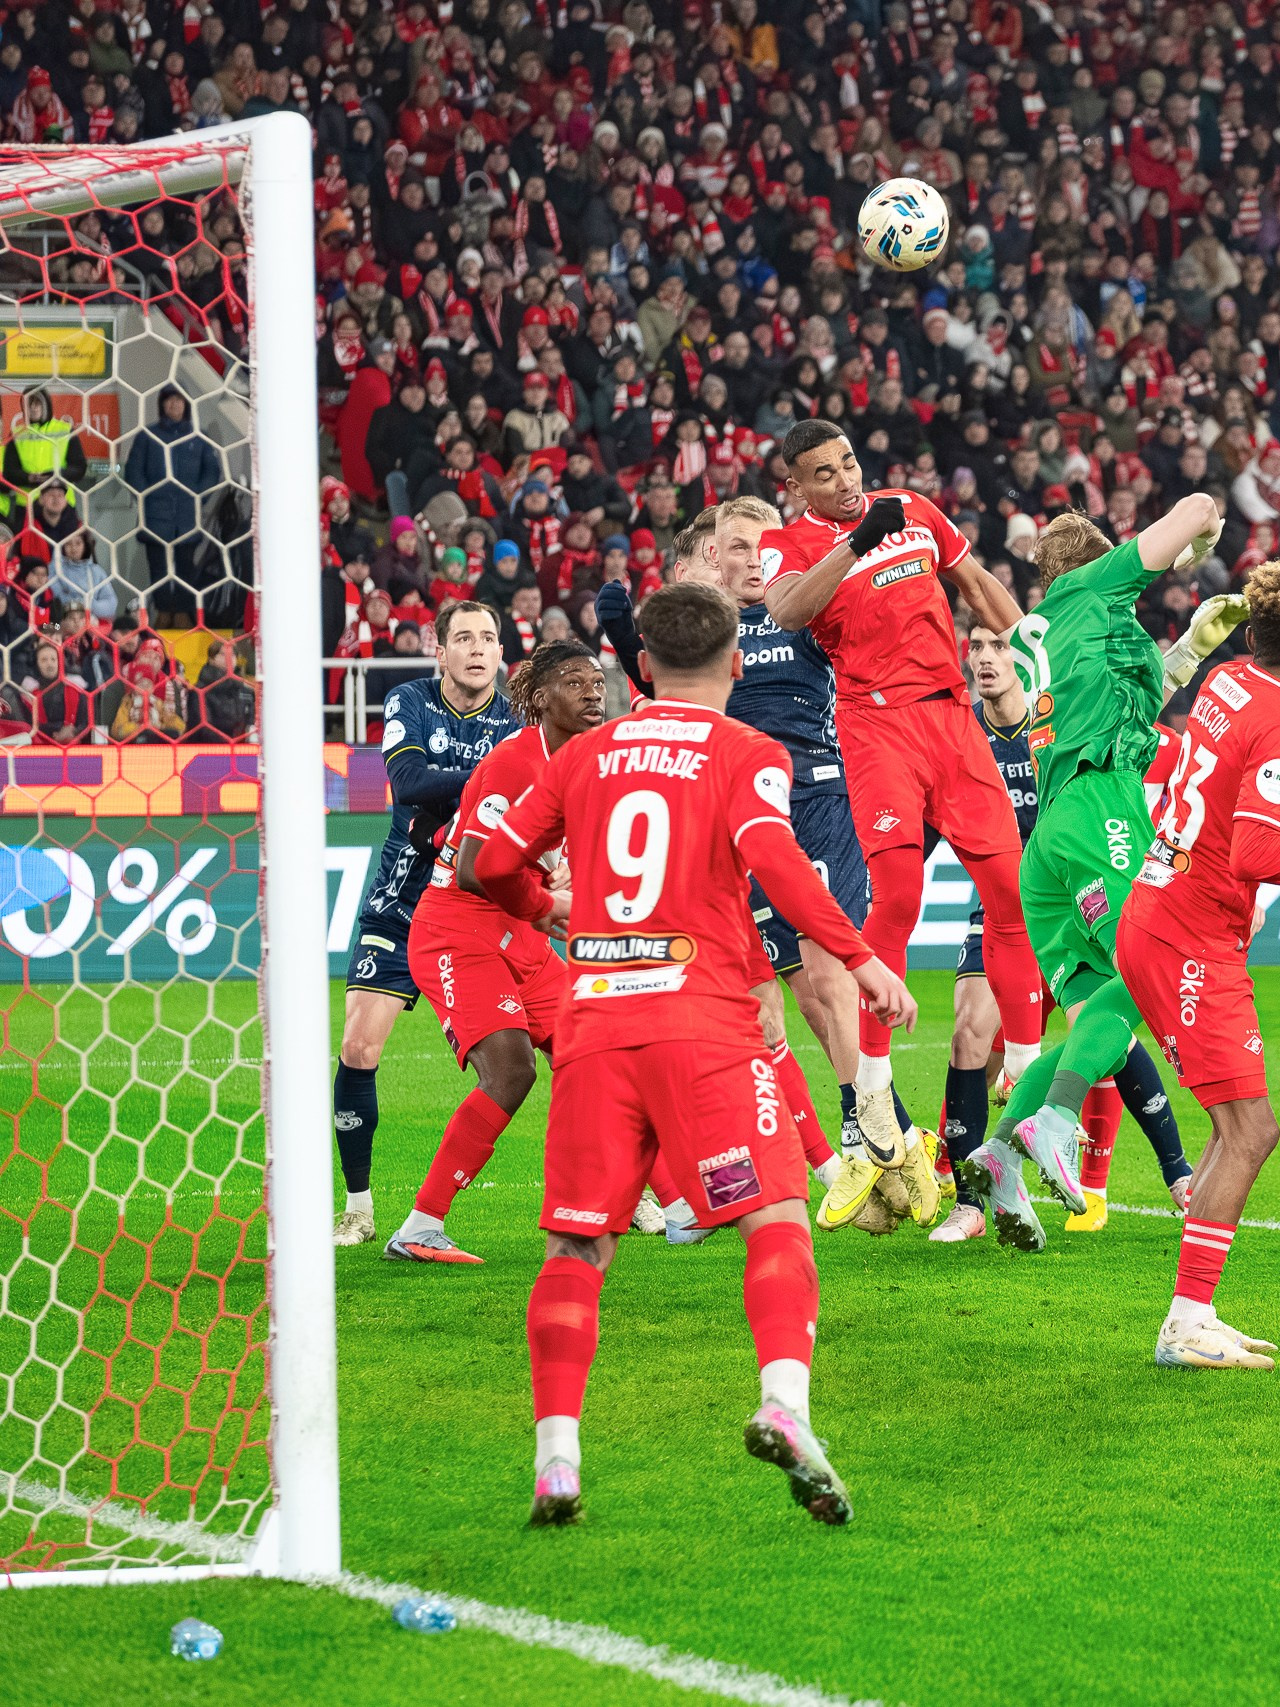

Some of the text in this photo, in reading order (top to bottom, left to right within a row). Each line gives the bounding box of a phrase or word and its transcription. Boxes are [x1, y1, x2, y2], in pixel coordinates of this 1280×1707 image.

[875, 561, 921, 588] WINLINE
[623, 722, 699, 738] МИРАТОРГ
[1189, 695, 1232, 743] ЖЕДСОН
[597, 745, 709, 781] УГАЛЬДЕ
[604, 789, 670, 924] 9
[576, 938, 668, 960] WINLINE
[612, 980, 671, 993] Маркет
[697, 1145, 750, 1173] ЛУКОЙЛ
[552, 1207, 610, 1226] GENESIS
